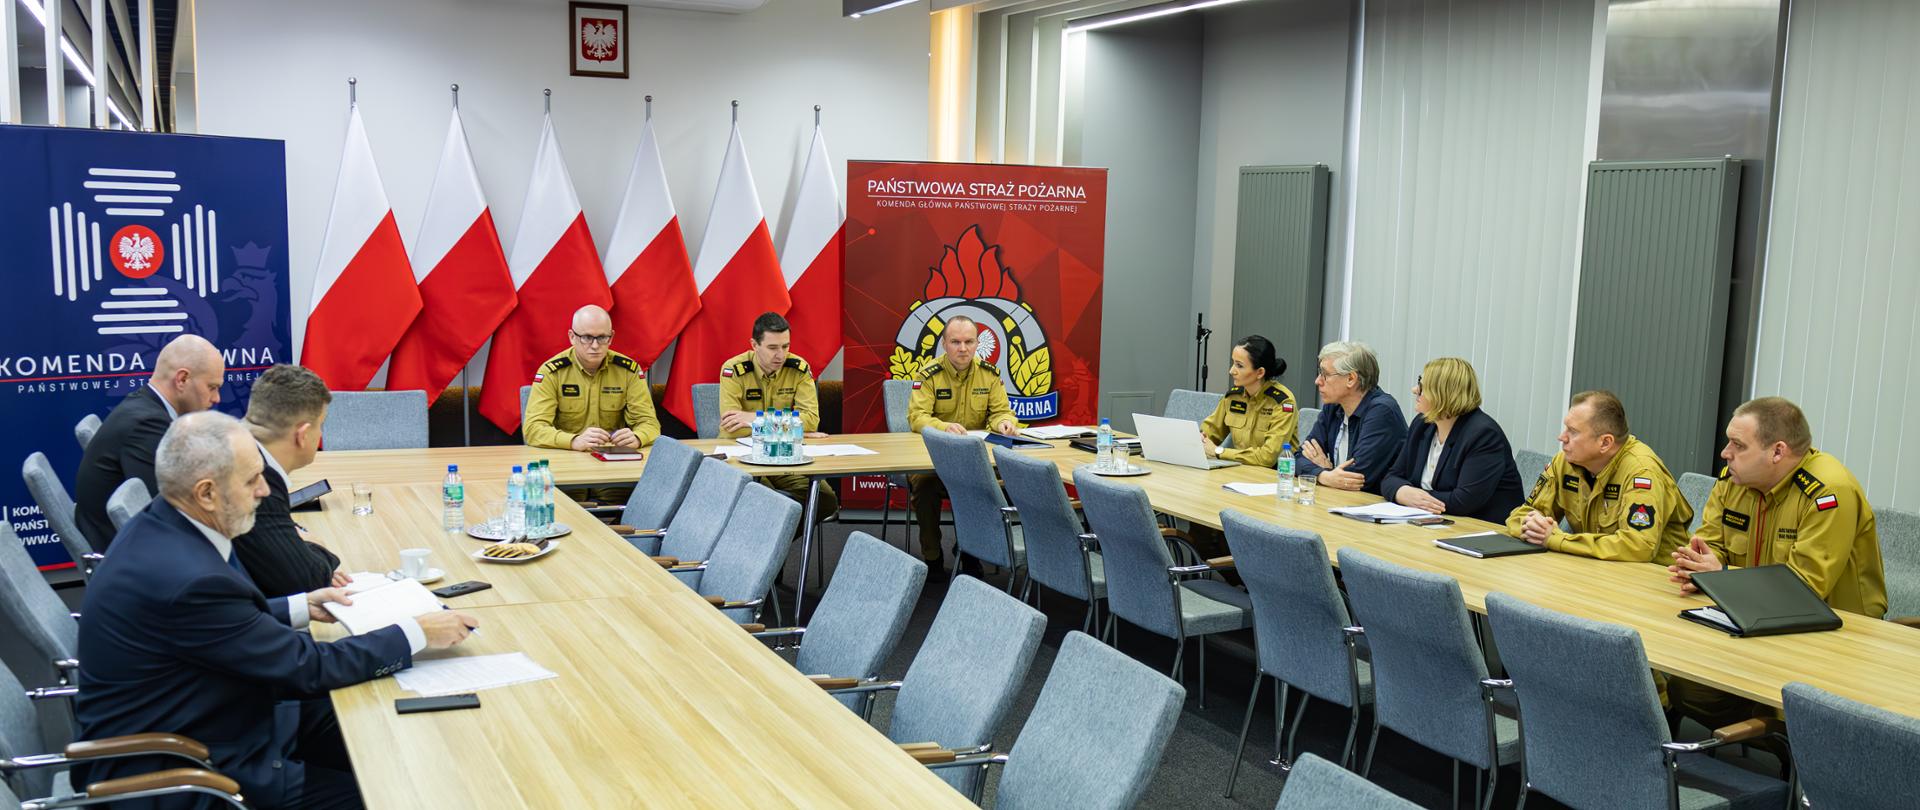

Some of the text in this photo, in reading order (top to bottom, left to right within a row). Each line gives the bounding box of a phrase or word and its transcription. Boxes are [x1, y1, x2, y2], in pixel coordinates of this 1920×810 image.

[867, 177, 1087, 199] PAŃSTWOWA STRAŻ POŻARNA
[876, 199, 1078, 214] KOMENDA GŁÓWNA PAŃSTWOWEJ STRAŻY POŻARNEJ
[0, 347, 274, 377] KOMENDA WNA
[17, 379, 119, 394] PAŃSTWOWEJ
[1009, 399, 1052, 416] ŻARNA
[13, 519, 49, 532] PAŃST
